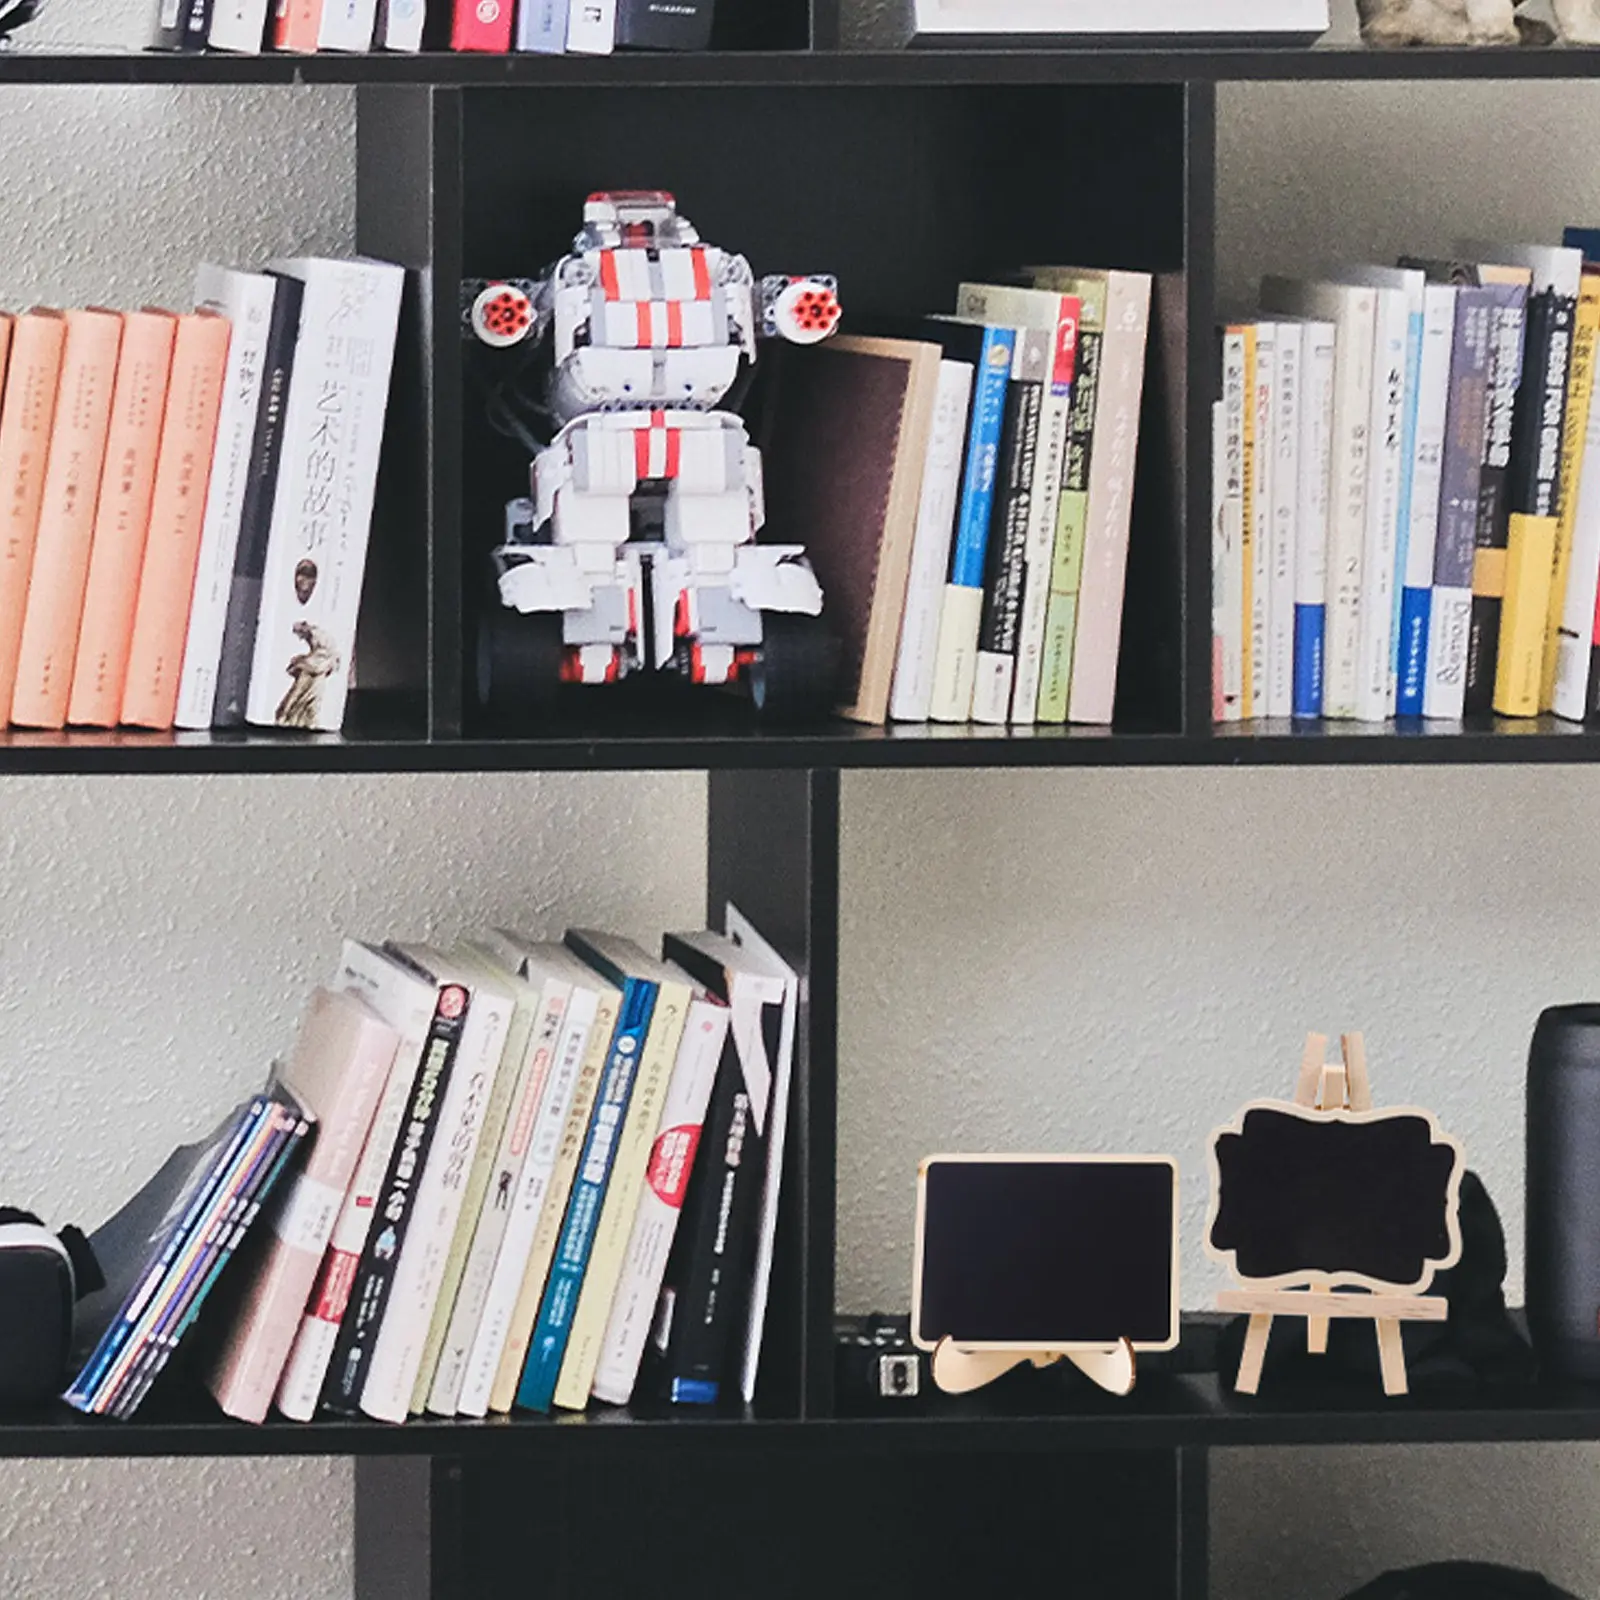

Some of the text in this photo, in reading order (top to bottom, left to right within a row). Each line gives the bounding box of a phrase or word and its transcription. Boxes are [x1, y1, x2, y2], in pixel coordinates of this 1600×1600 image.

[301, 380, 347, 552] 艺术的故事
